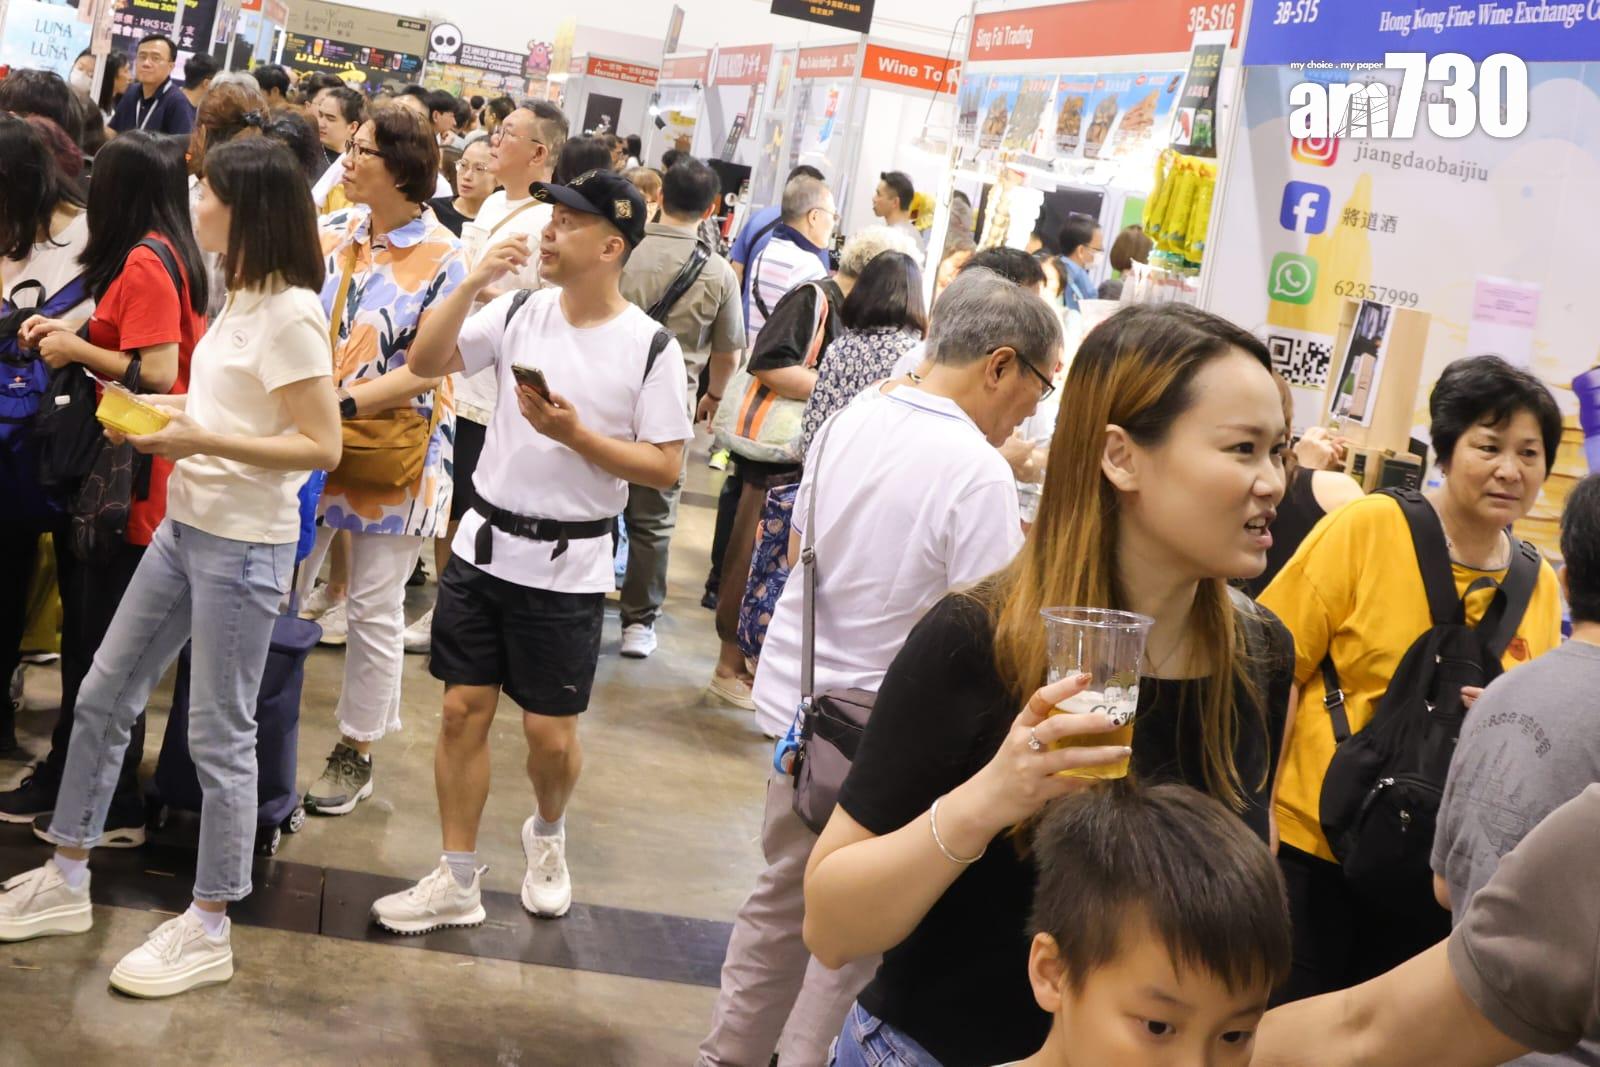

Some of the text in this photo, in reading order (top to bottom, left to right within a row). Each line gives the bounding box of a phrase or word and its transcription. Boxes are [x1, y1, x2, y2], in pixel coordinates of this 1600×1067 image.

[1187, 3, 1236, 32] 3B-S16
[1273, 0, 1321, 25] 3B-S15
[1379, 0, 1600, 37] Hong Kong Fine Wine Exchange C
[35, 18, 73, 38] LUNA
[1004, 24, 1034, 50] Trading
[31, 41, 68, 61] LUNA
[878, 56, 919, 78] Wine
[1353, 141, 1489, 182] jiangdaobaijiu
[1342, 207, 1400, 234] 將道酒
[1334, 280, 1419, 308] 62357999
